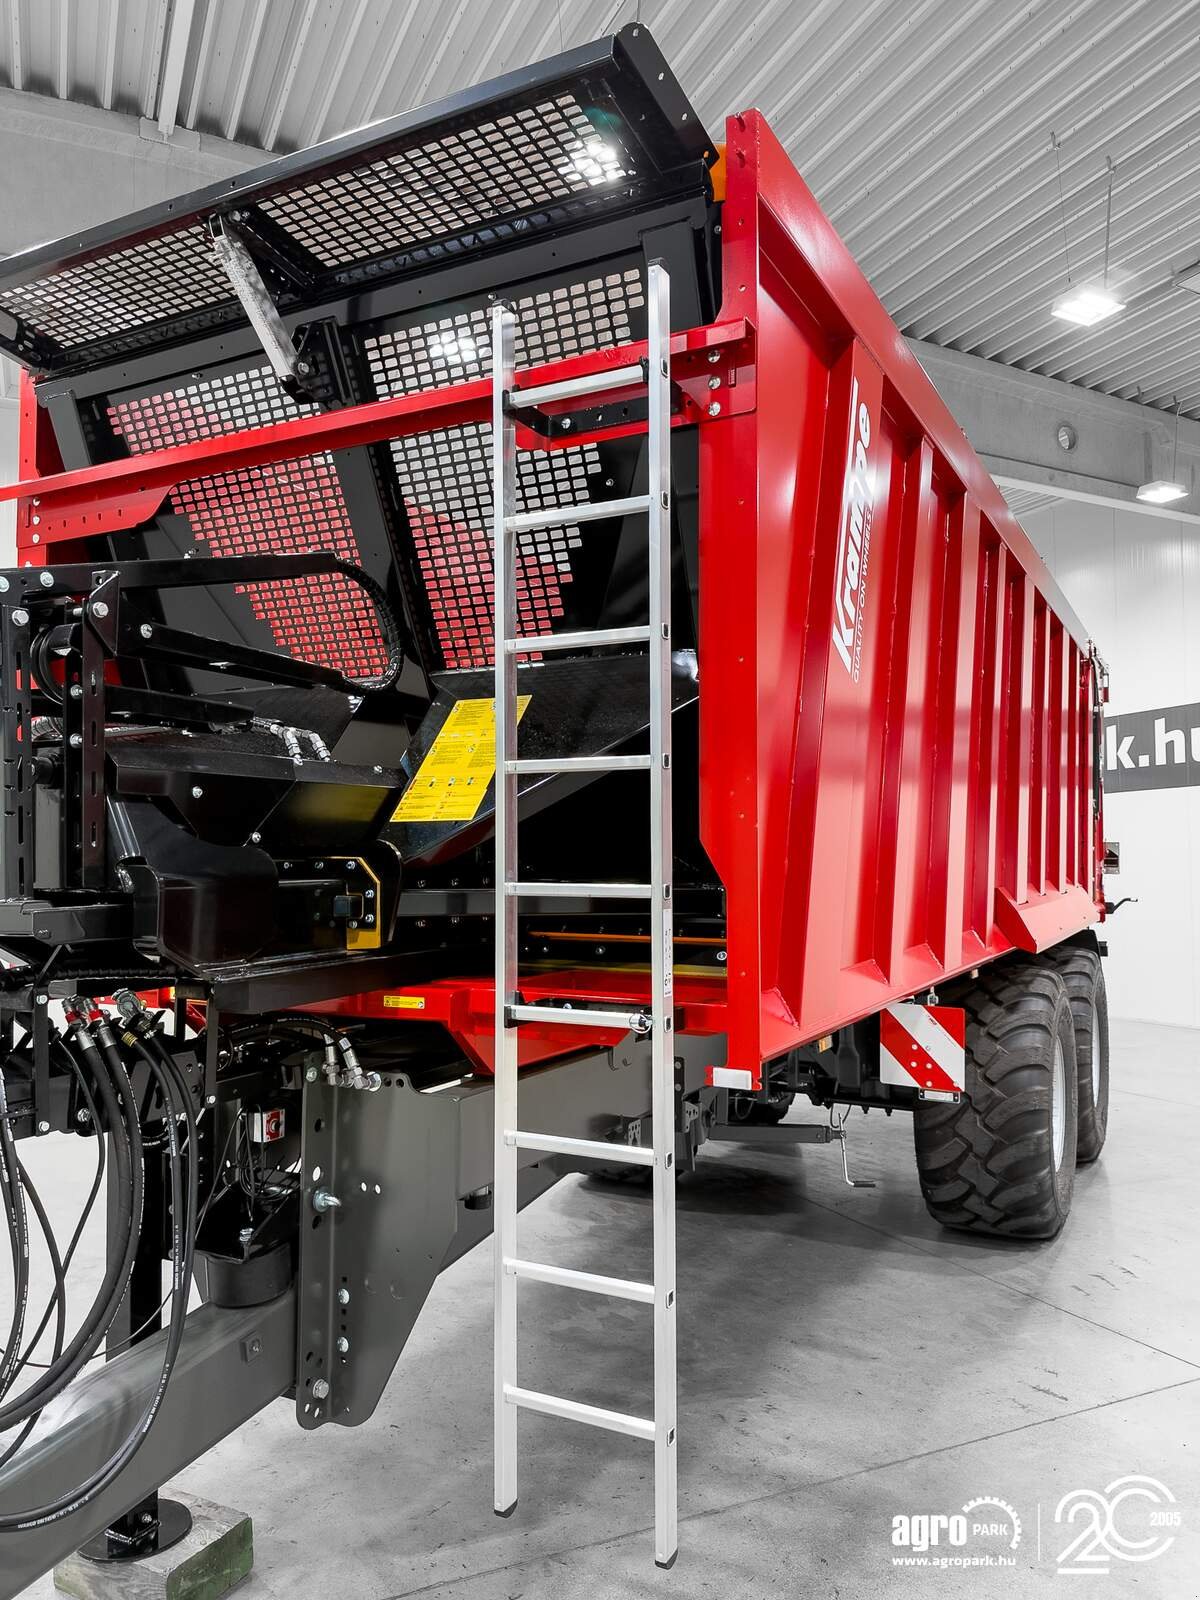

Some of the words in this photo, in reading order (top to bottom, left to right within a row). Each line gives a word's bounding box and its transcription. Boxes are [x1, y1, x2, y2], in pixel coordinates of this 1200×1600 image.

[833, 377, 873, 674] Krampe
[861, 510, 872, 577] WHEELS
[859, 585, 867, 608] ON
[853, 611, 865, 684] QUALITY
